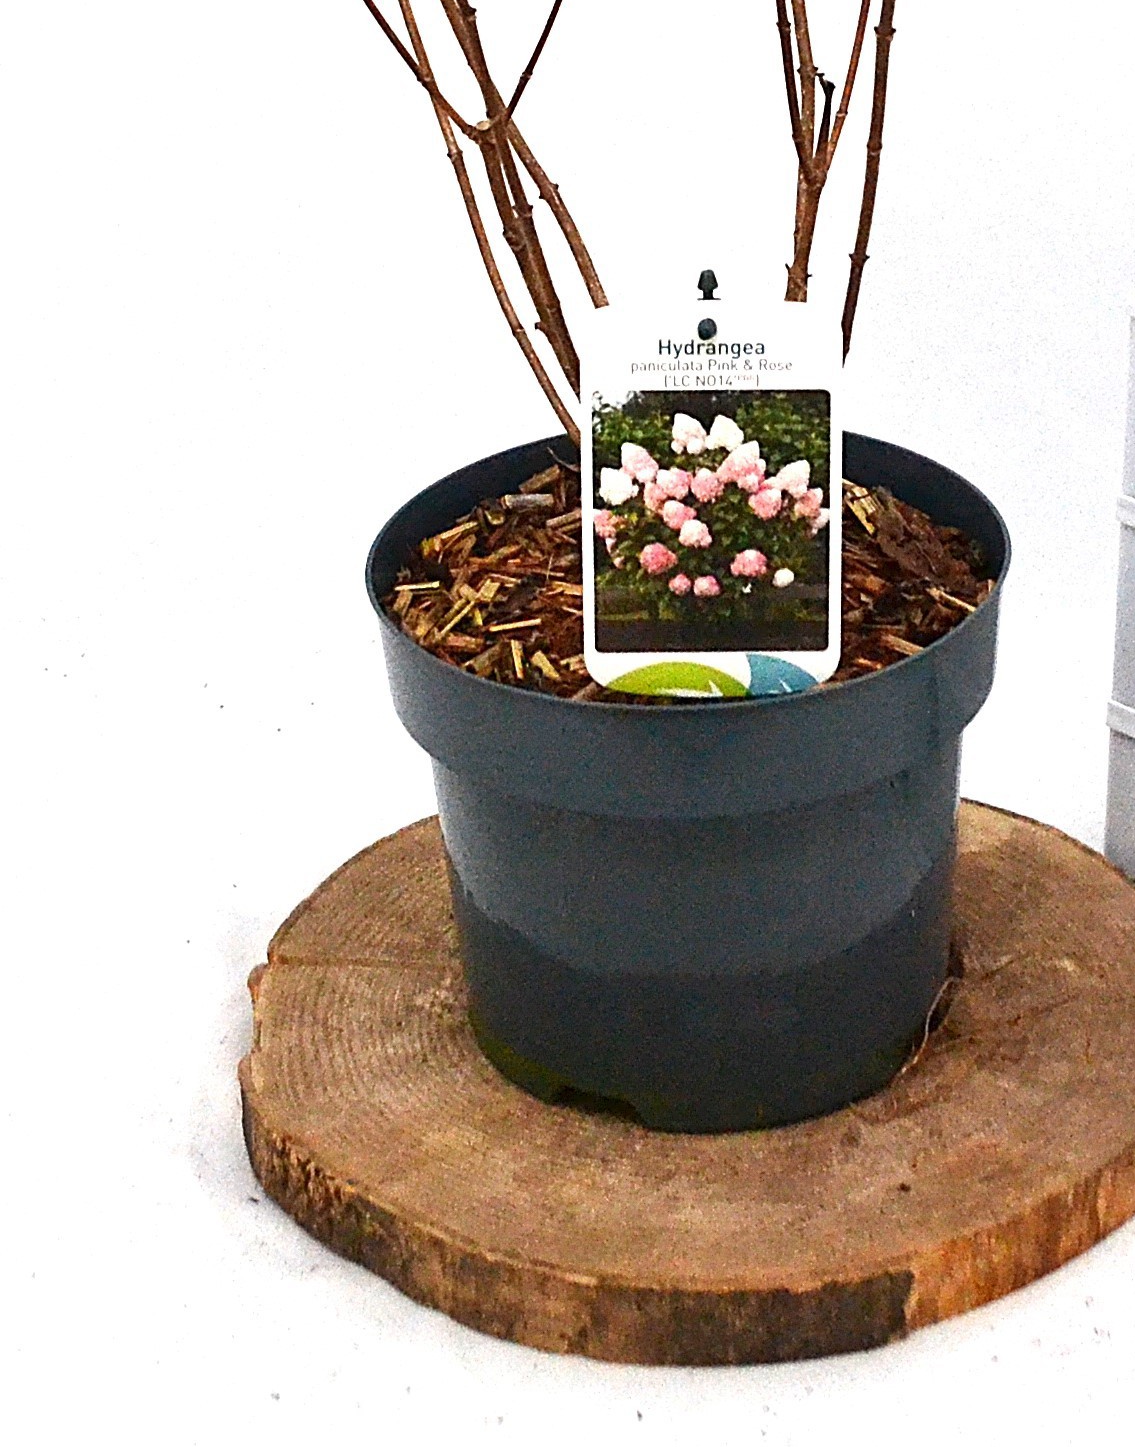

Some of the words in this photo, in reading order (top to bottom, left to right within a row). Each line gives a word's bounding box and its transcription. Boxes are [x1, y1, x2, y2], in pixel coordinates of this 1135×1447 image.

[658, 338, 765, 359] Hydrangea
[630, 360, 703, 375] paniculata
[708, 359, 738, 371] Pink
[743, 359, 753, 371] &
[758, 359, 793, 371] Rose
